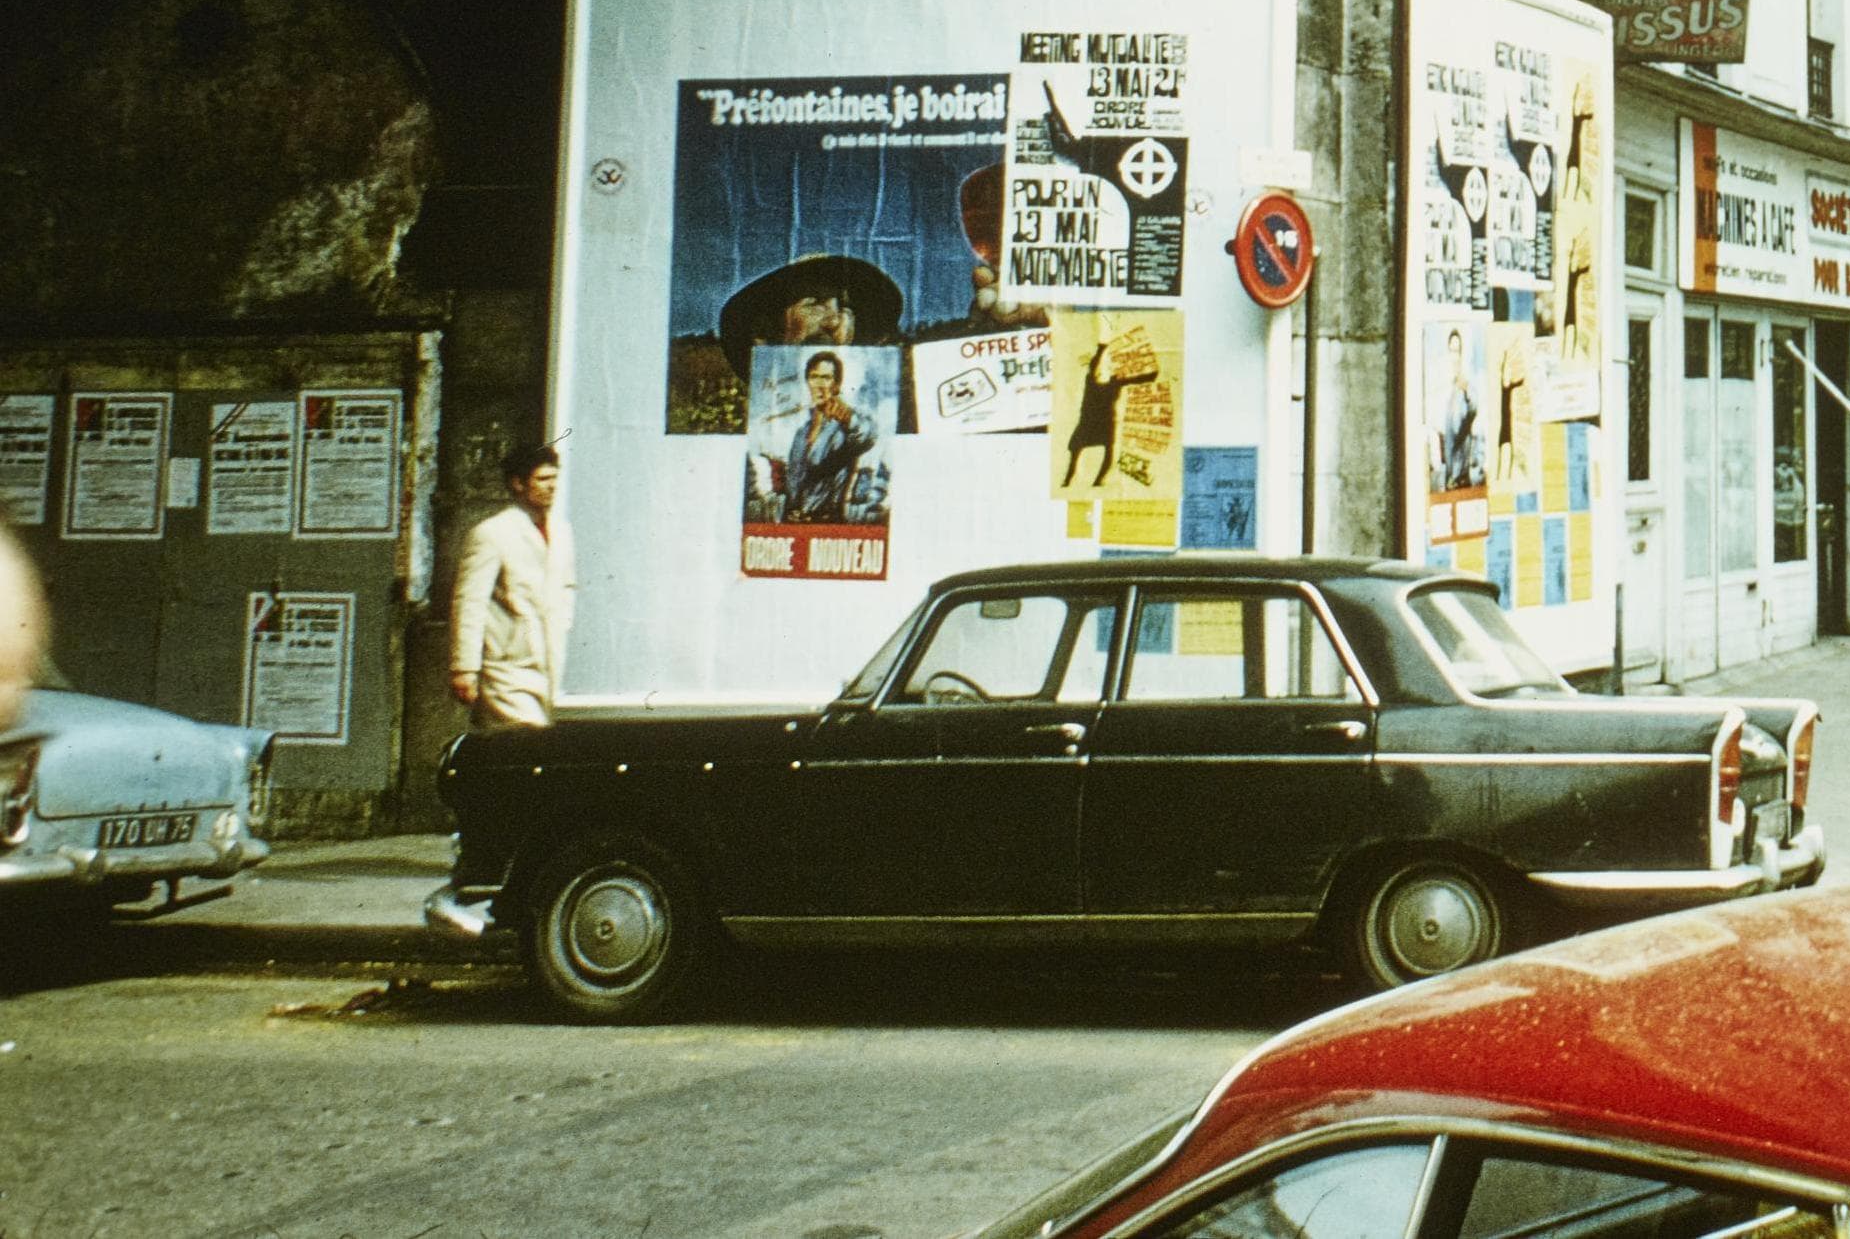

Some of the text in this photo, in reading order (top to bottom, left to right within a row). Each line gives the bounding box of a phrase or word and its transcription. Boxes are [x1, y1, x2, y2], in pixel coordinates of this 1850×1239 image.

[1020, 33, 1081, 63] MEETING
[1087, 67, 1111, 97] 13
[891, 85, 918, 128] je
[920, 83, 1006, 120] boirai
[1013, 179, 1100, 208] POUR UN
[1013, 211, 1041, 243] 13
[961, 336, 1019, 359] OFFRE
[808, 538, 885, 574] NOUVEAU
[104, 819, 141, 845] 170
